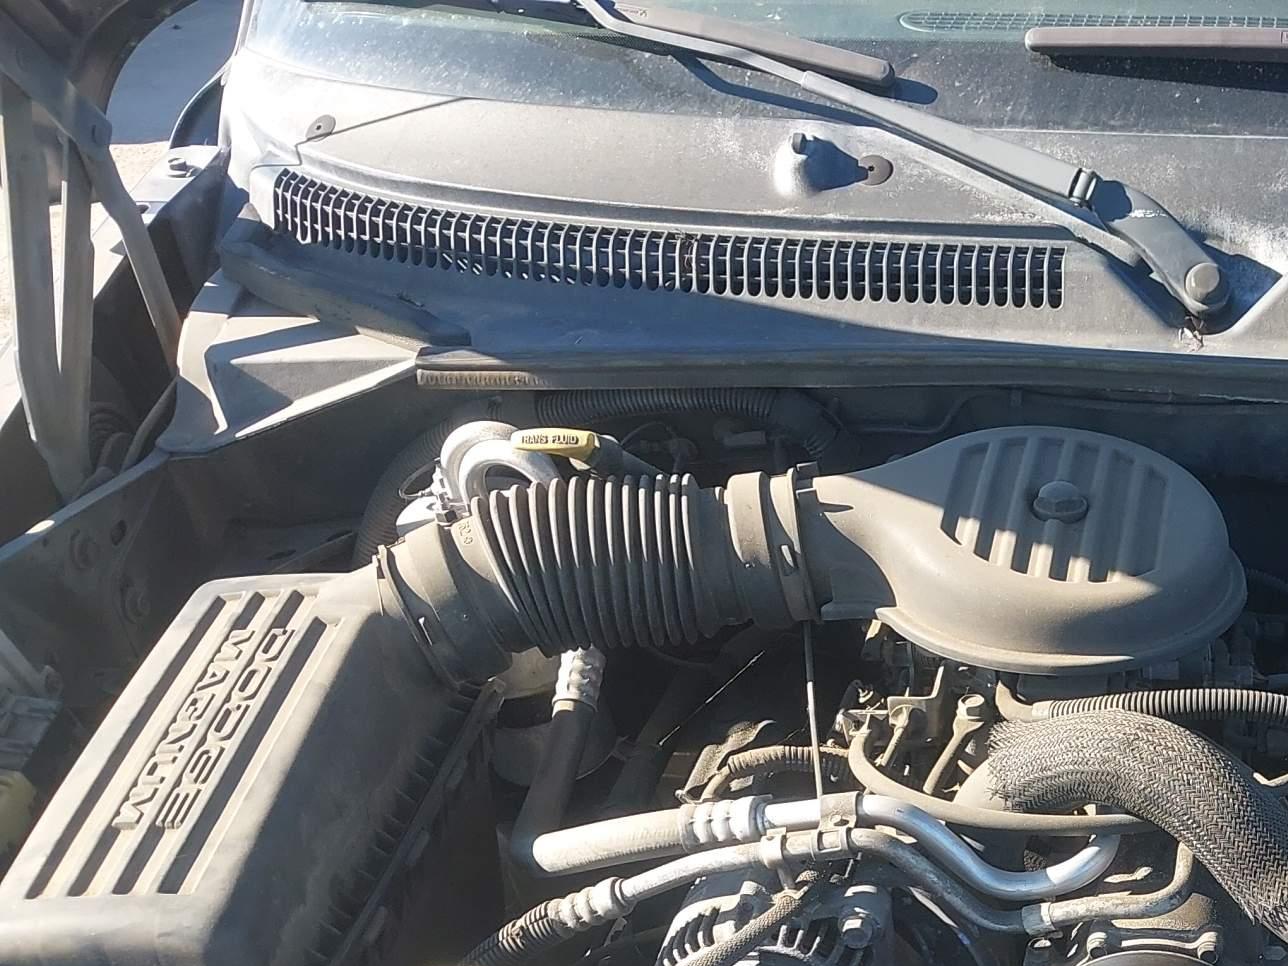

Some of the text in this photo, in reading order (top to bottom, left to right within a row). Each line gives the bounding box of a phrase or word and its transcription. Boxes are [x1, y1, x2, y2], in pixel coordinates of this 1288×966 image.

[552, 435, 579, 445] FLUID
[111, 628, 256, 830] MAGNUM
[155, 628, 297, 830] DODGE
